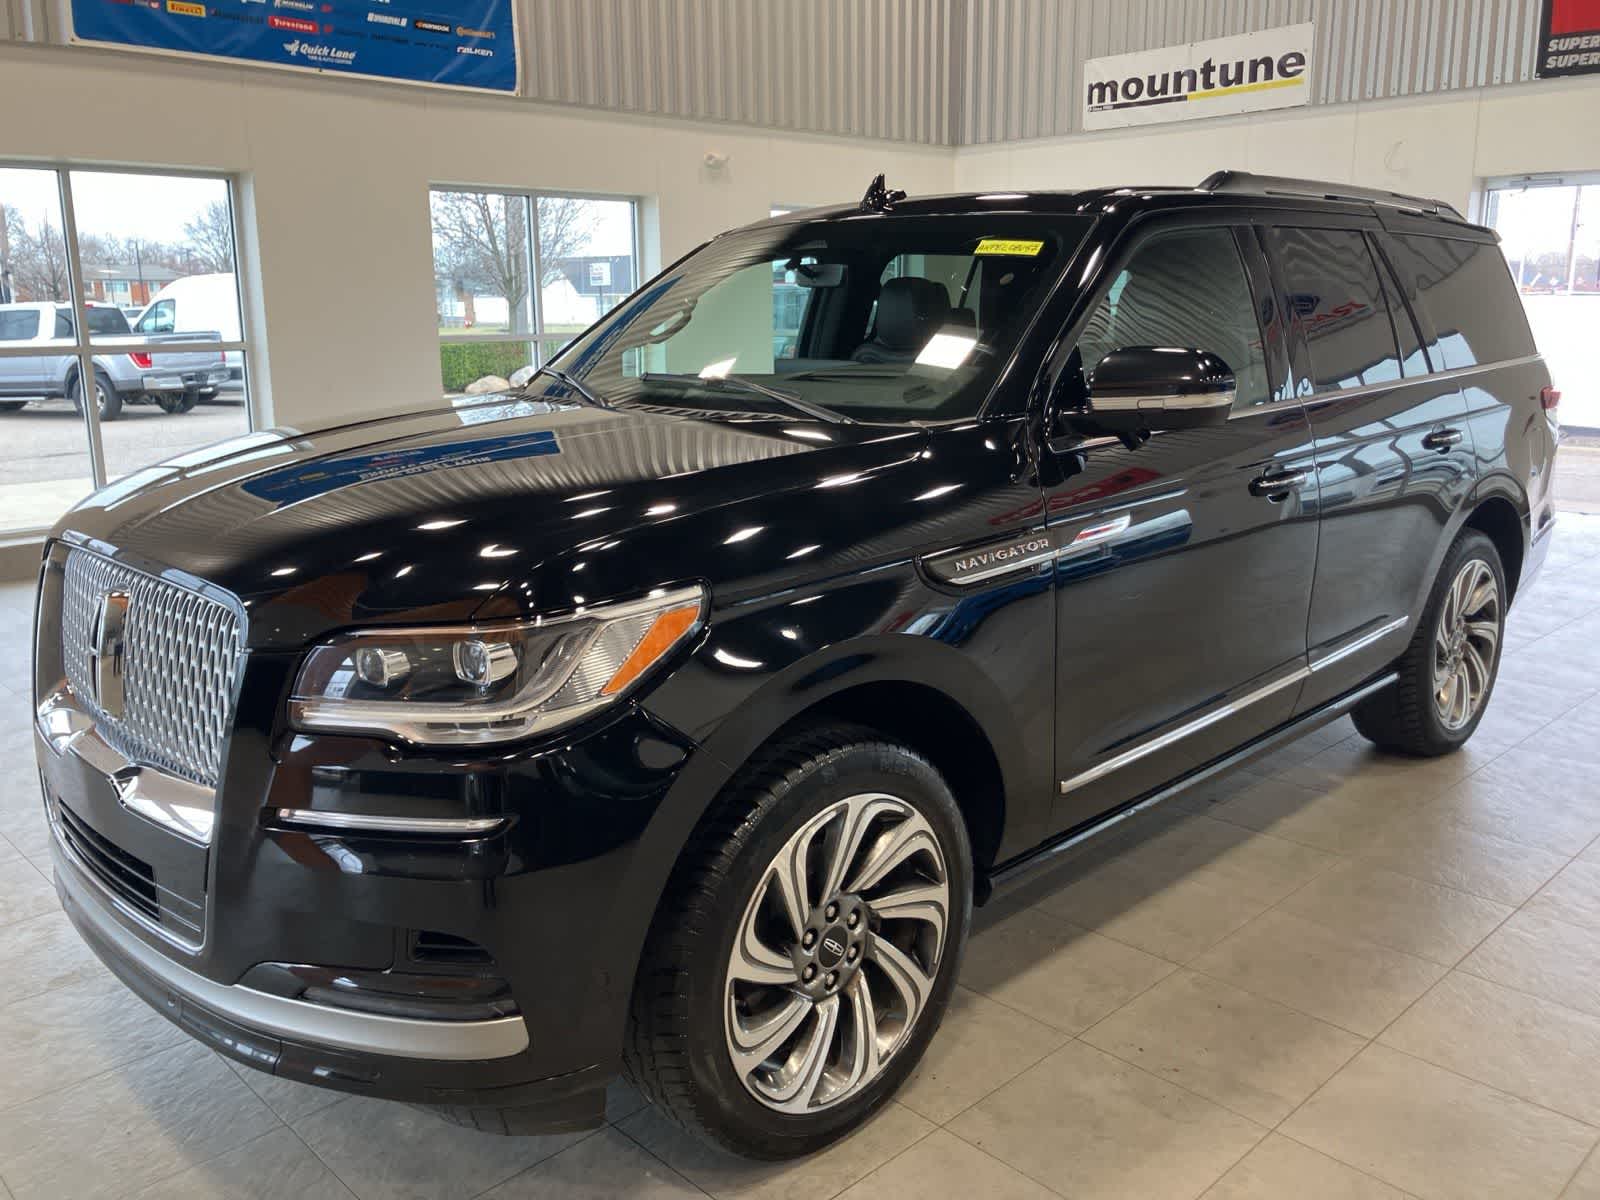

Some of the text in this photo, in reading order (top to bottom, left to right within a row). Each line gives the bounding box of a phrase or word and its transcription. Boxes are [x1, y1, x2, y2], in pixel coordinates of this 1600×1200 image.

[300, 43, 357, 60] Quick Lane
[456, 45, 494, 57] FALKEN
[1087, 51, 1306, 105] mountune
[954, 538, 1050, 572] NAVIGATOR
